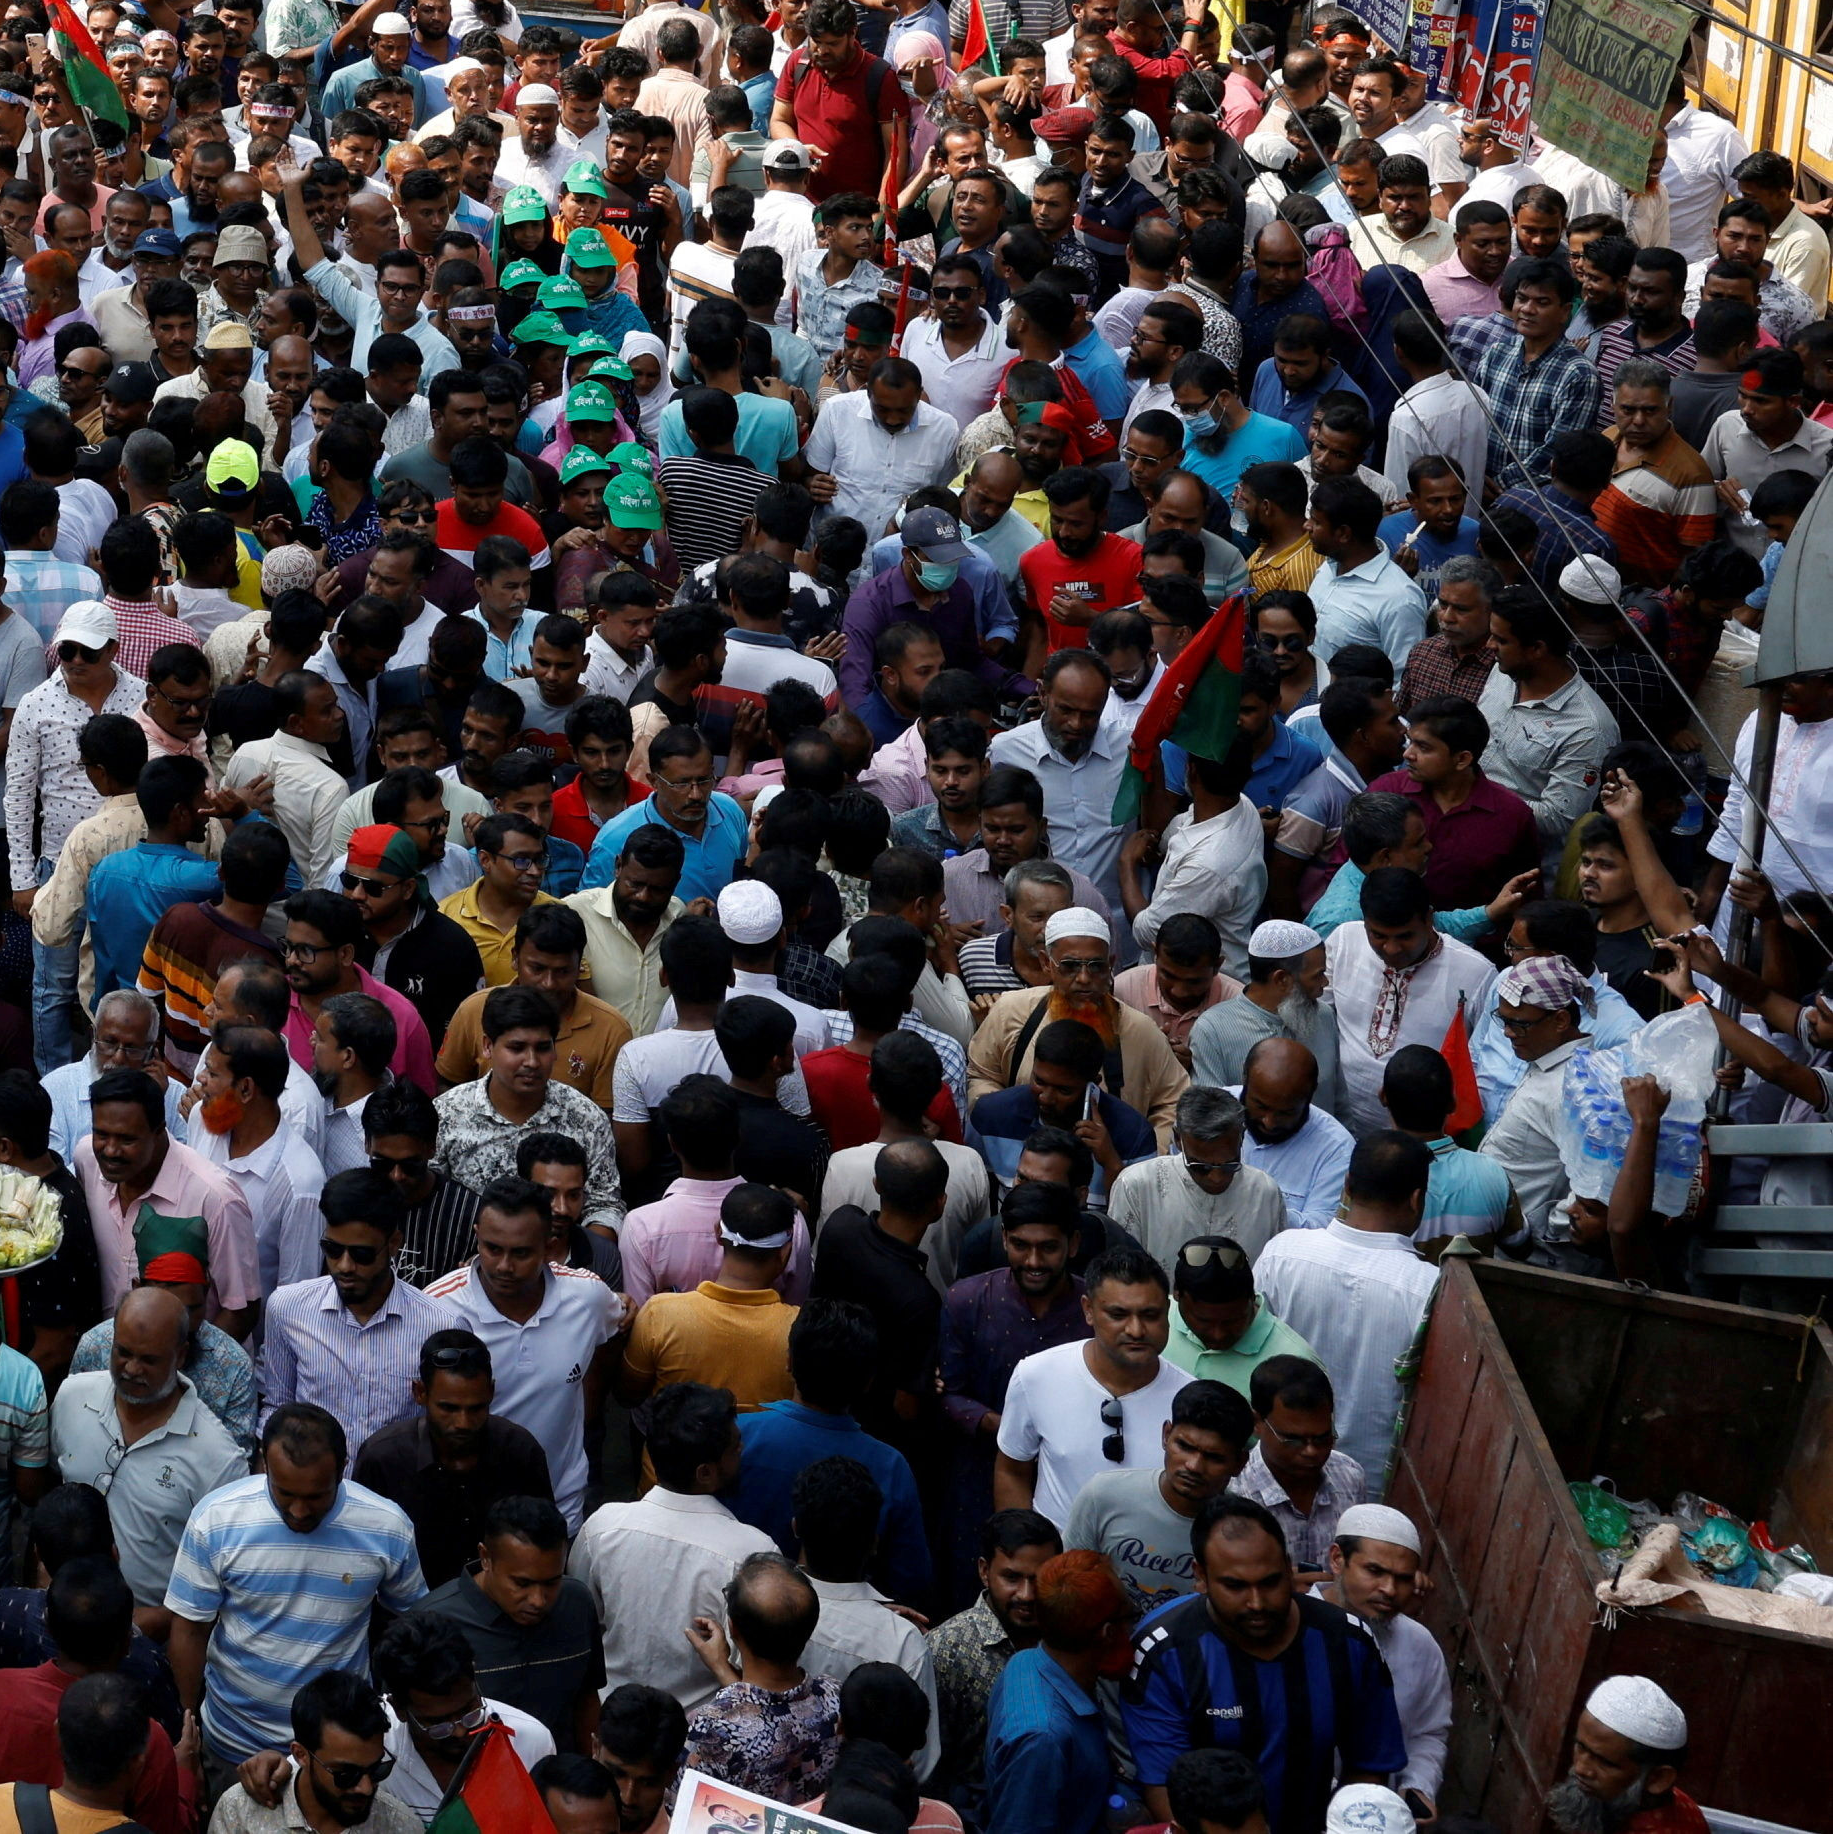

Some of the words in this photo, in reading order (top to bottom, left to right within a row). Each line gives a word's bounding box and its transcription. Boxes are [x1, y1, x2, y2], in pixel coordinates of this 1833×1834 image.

[574, 396, 594, 407] মহিলা
[595, 397, 605, 407] দল
[567, 459, 584, 469] মহিলা
[620, 496, 641, 508] মহিলা
[642, 498, 653, 507] দল
[1065, 581, 1088, 592] HAPPY
[1118, 1537, 1177, 1574] Rice
[1206, 1705, 1243, 1719] capelli
